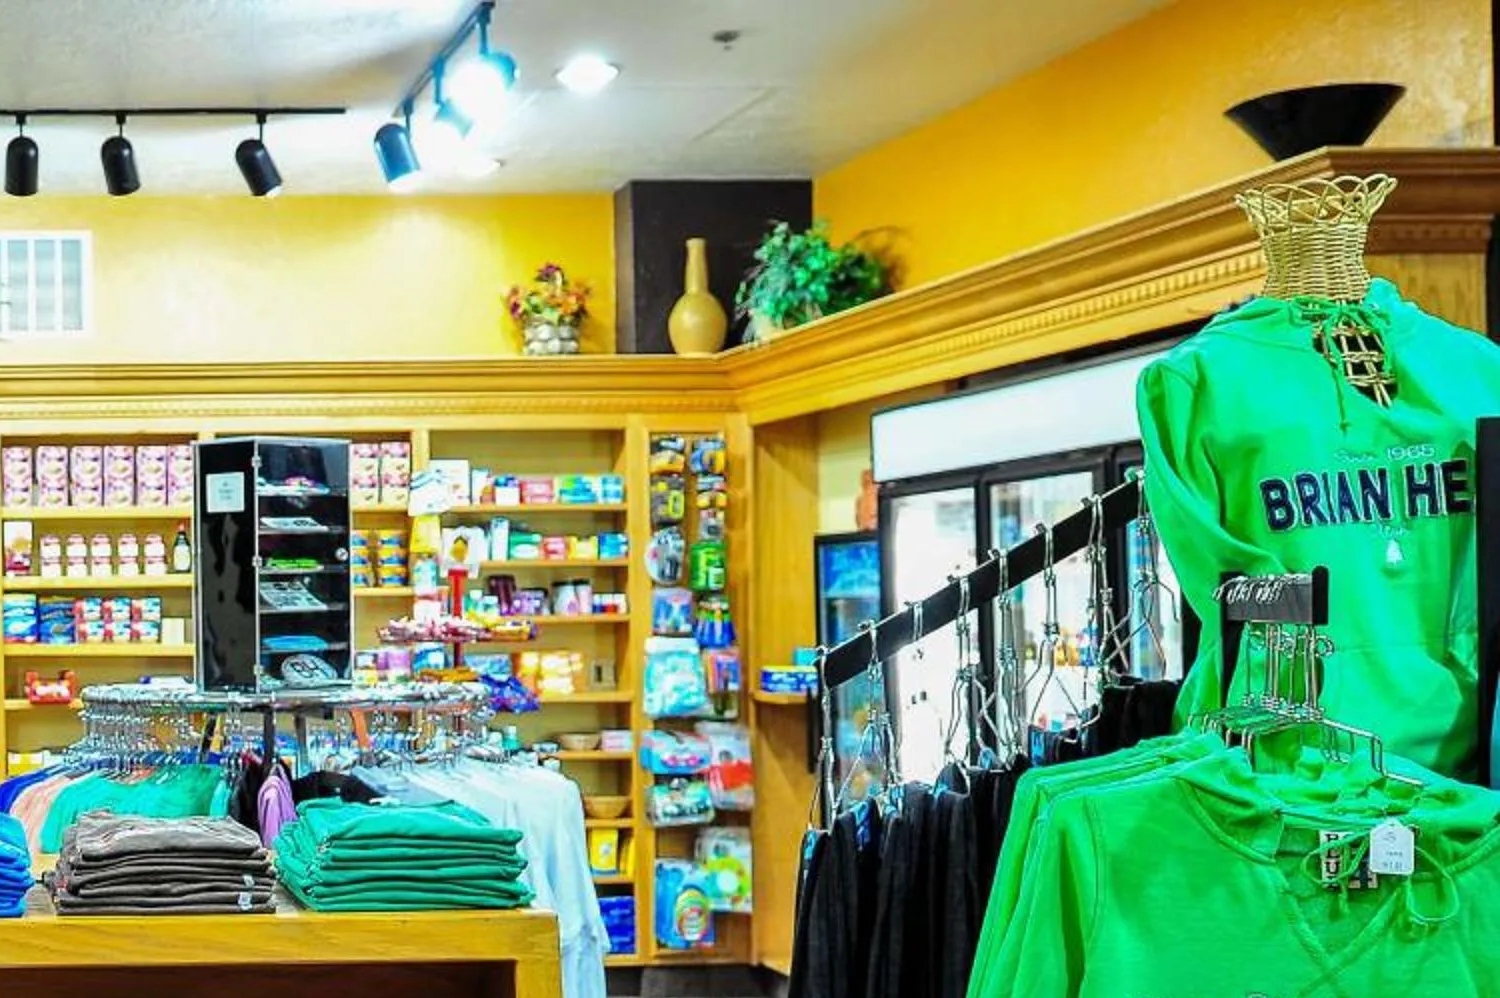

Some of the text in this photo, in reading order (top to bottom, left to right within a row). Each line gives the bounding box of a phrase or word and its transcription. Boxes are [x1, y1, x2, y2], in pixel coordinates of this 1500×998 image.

[1387, 443, 1435, 461] 1965
[1259, 457, 1476, 533] BRIAN HE
